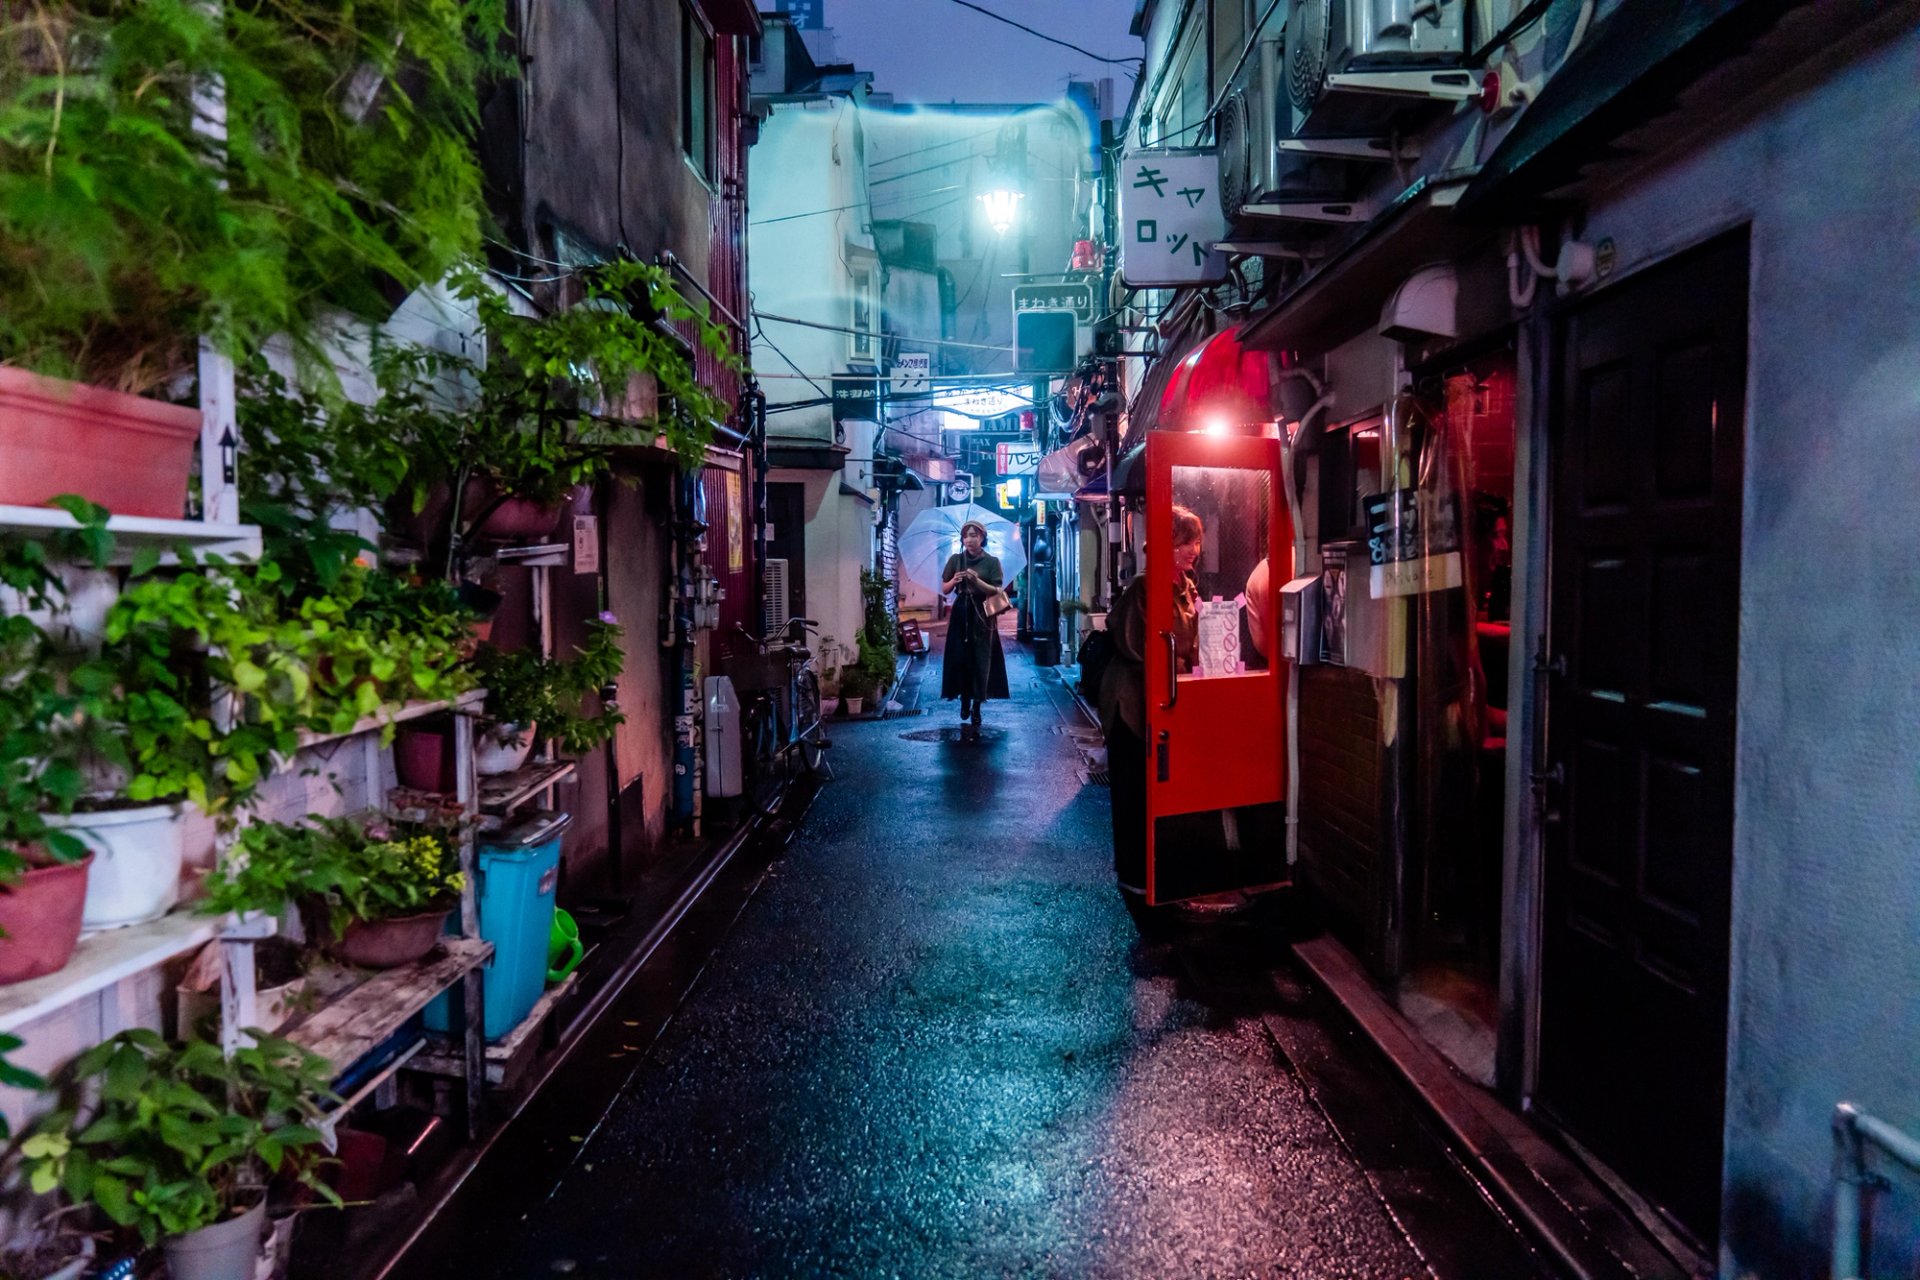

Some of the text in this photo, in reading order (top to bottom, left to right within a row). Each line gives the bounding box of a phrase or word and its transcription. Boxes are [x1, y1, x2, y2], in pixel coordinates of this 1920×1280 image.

[1018, 296, 1087, 309] まねき通り
